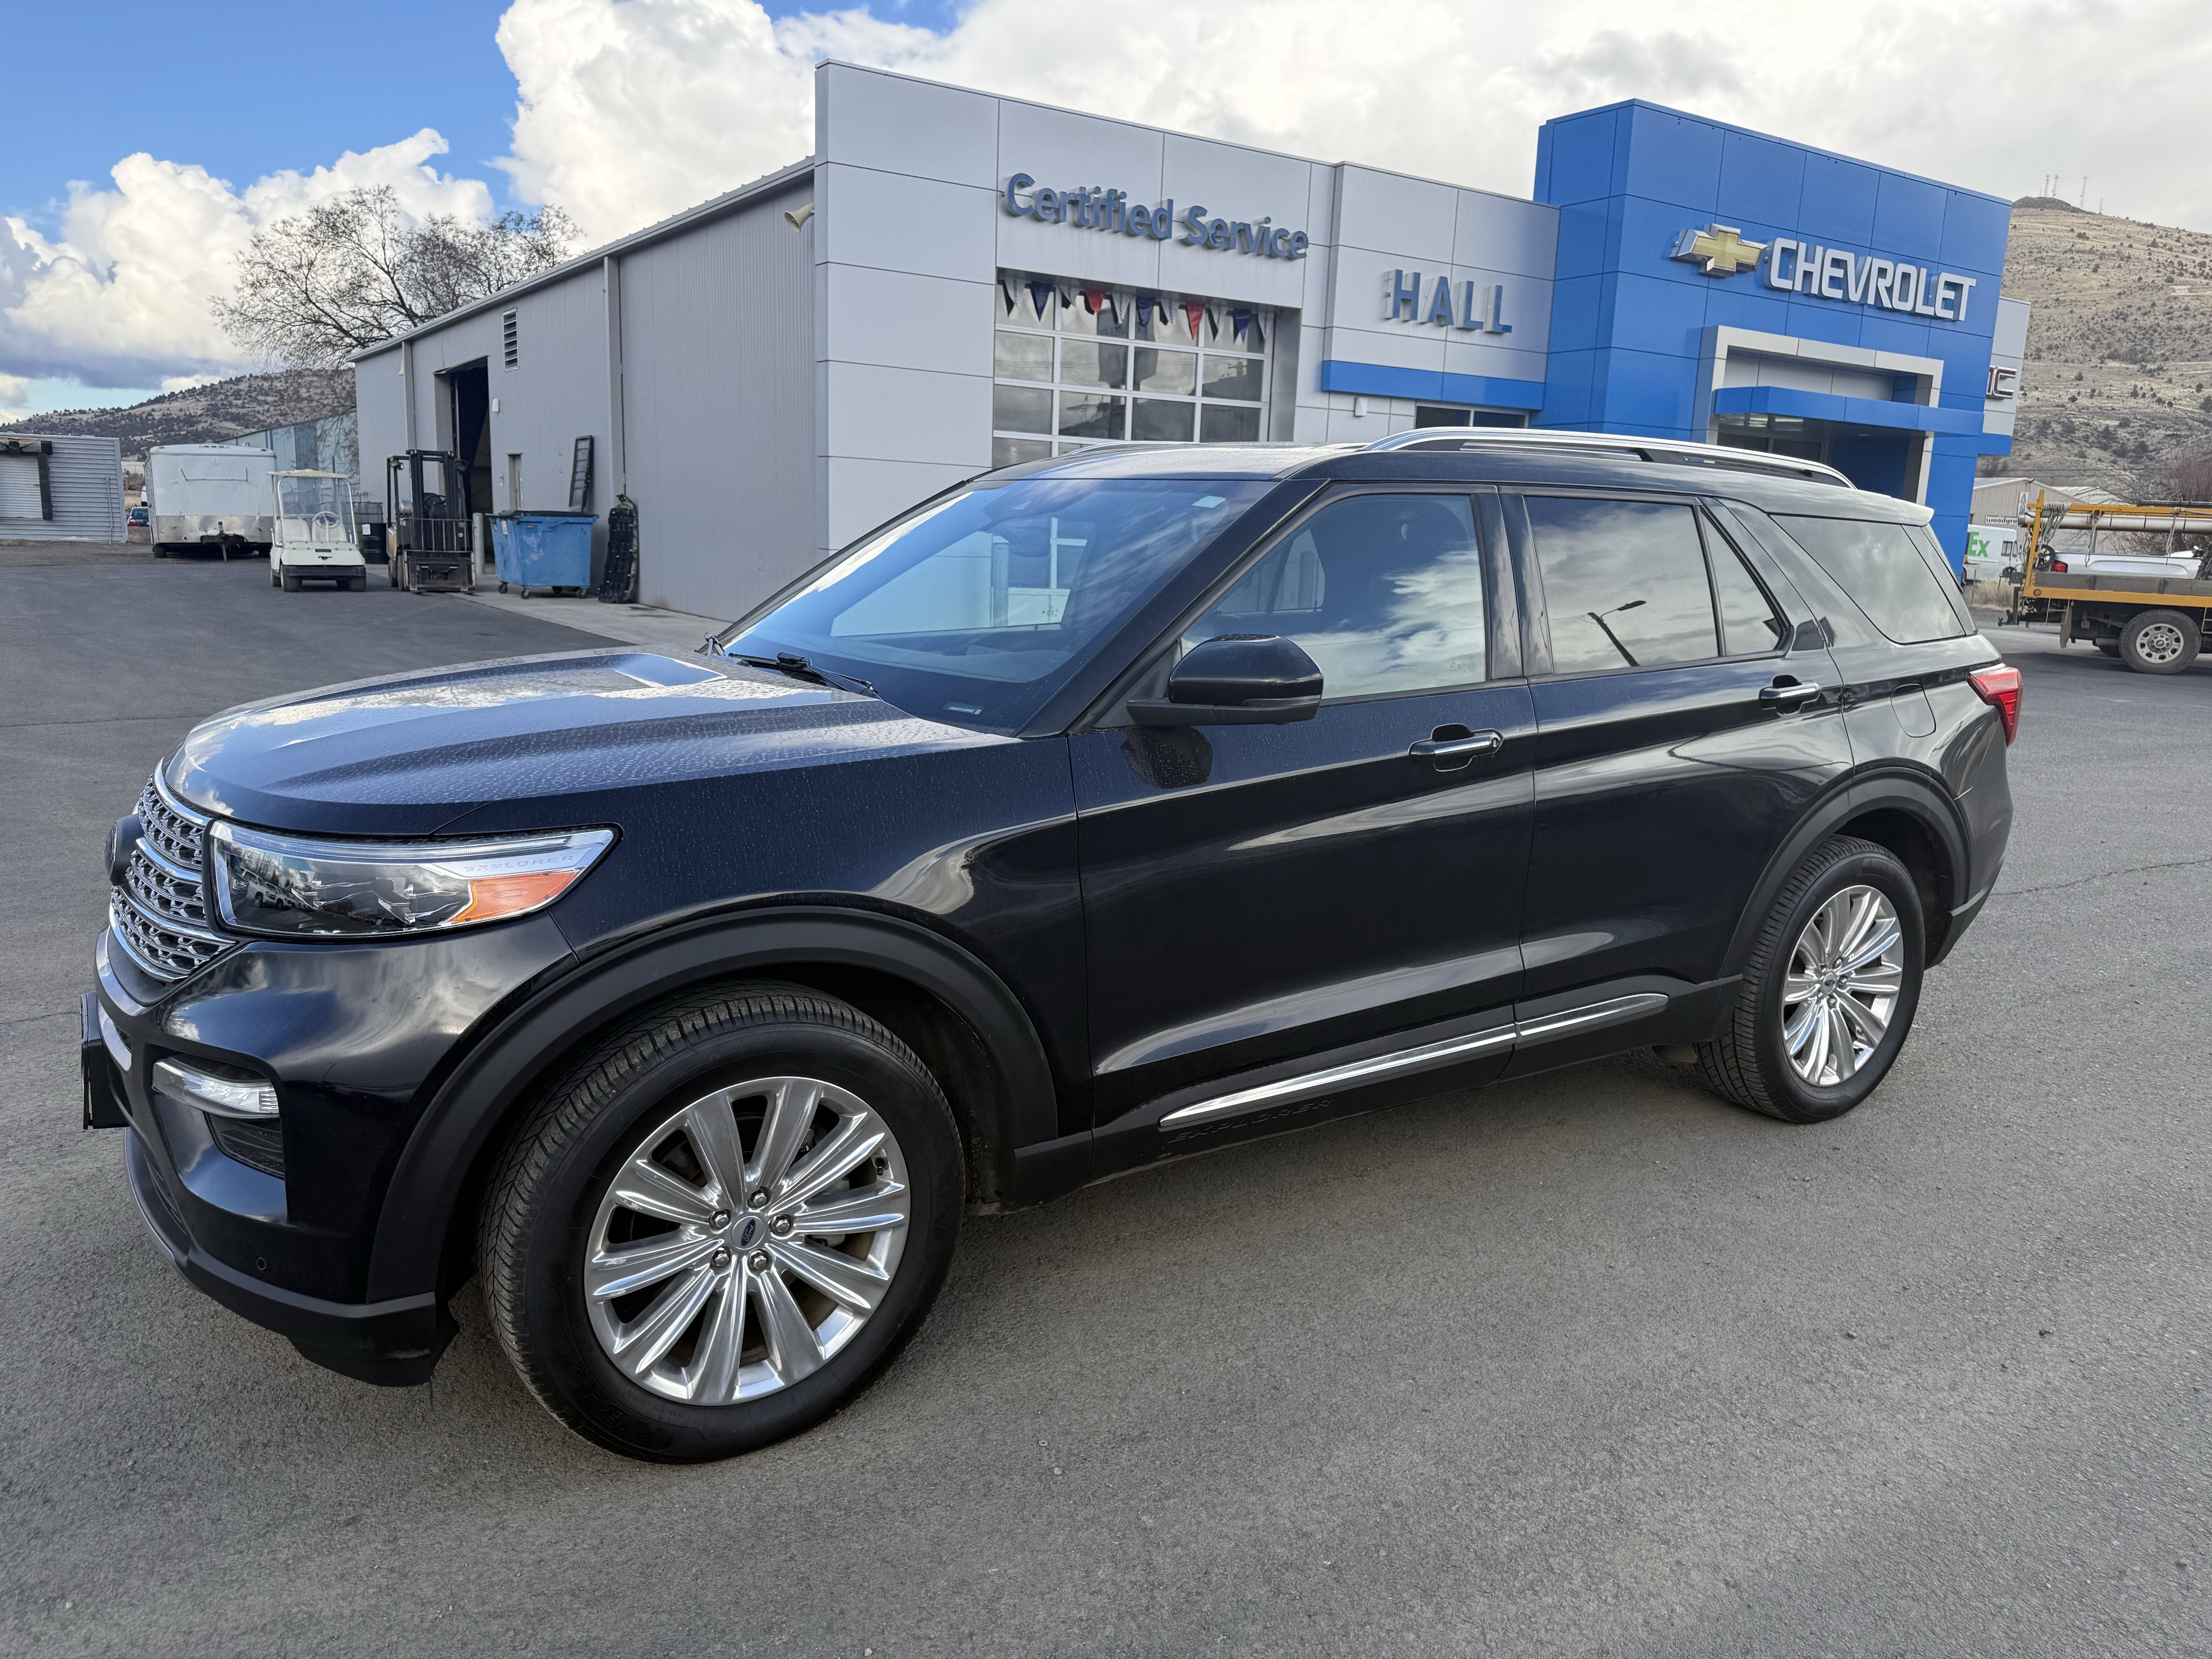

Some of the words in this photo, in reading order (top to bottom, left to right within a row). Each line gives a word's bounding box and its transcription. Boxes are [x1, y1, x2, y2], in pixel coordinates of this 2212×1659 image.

[1003, 173, 1173, 240] Certified
[1183, 205, 1309, 260] Service
[1388, 269, 1513, 334] HALL
[1769, 237, 1977, 321] CHEVROLET
[464, 855, 574, 872] EXPLORER
[743, 1224, 755, 1242] Ford
